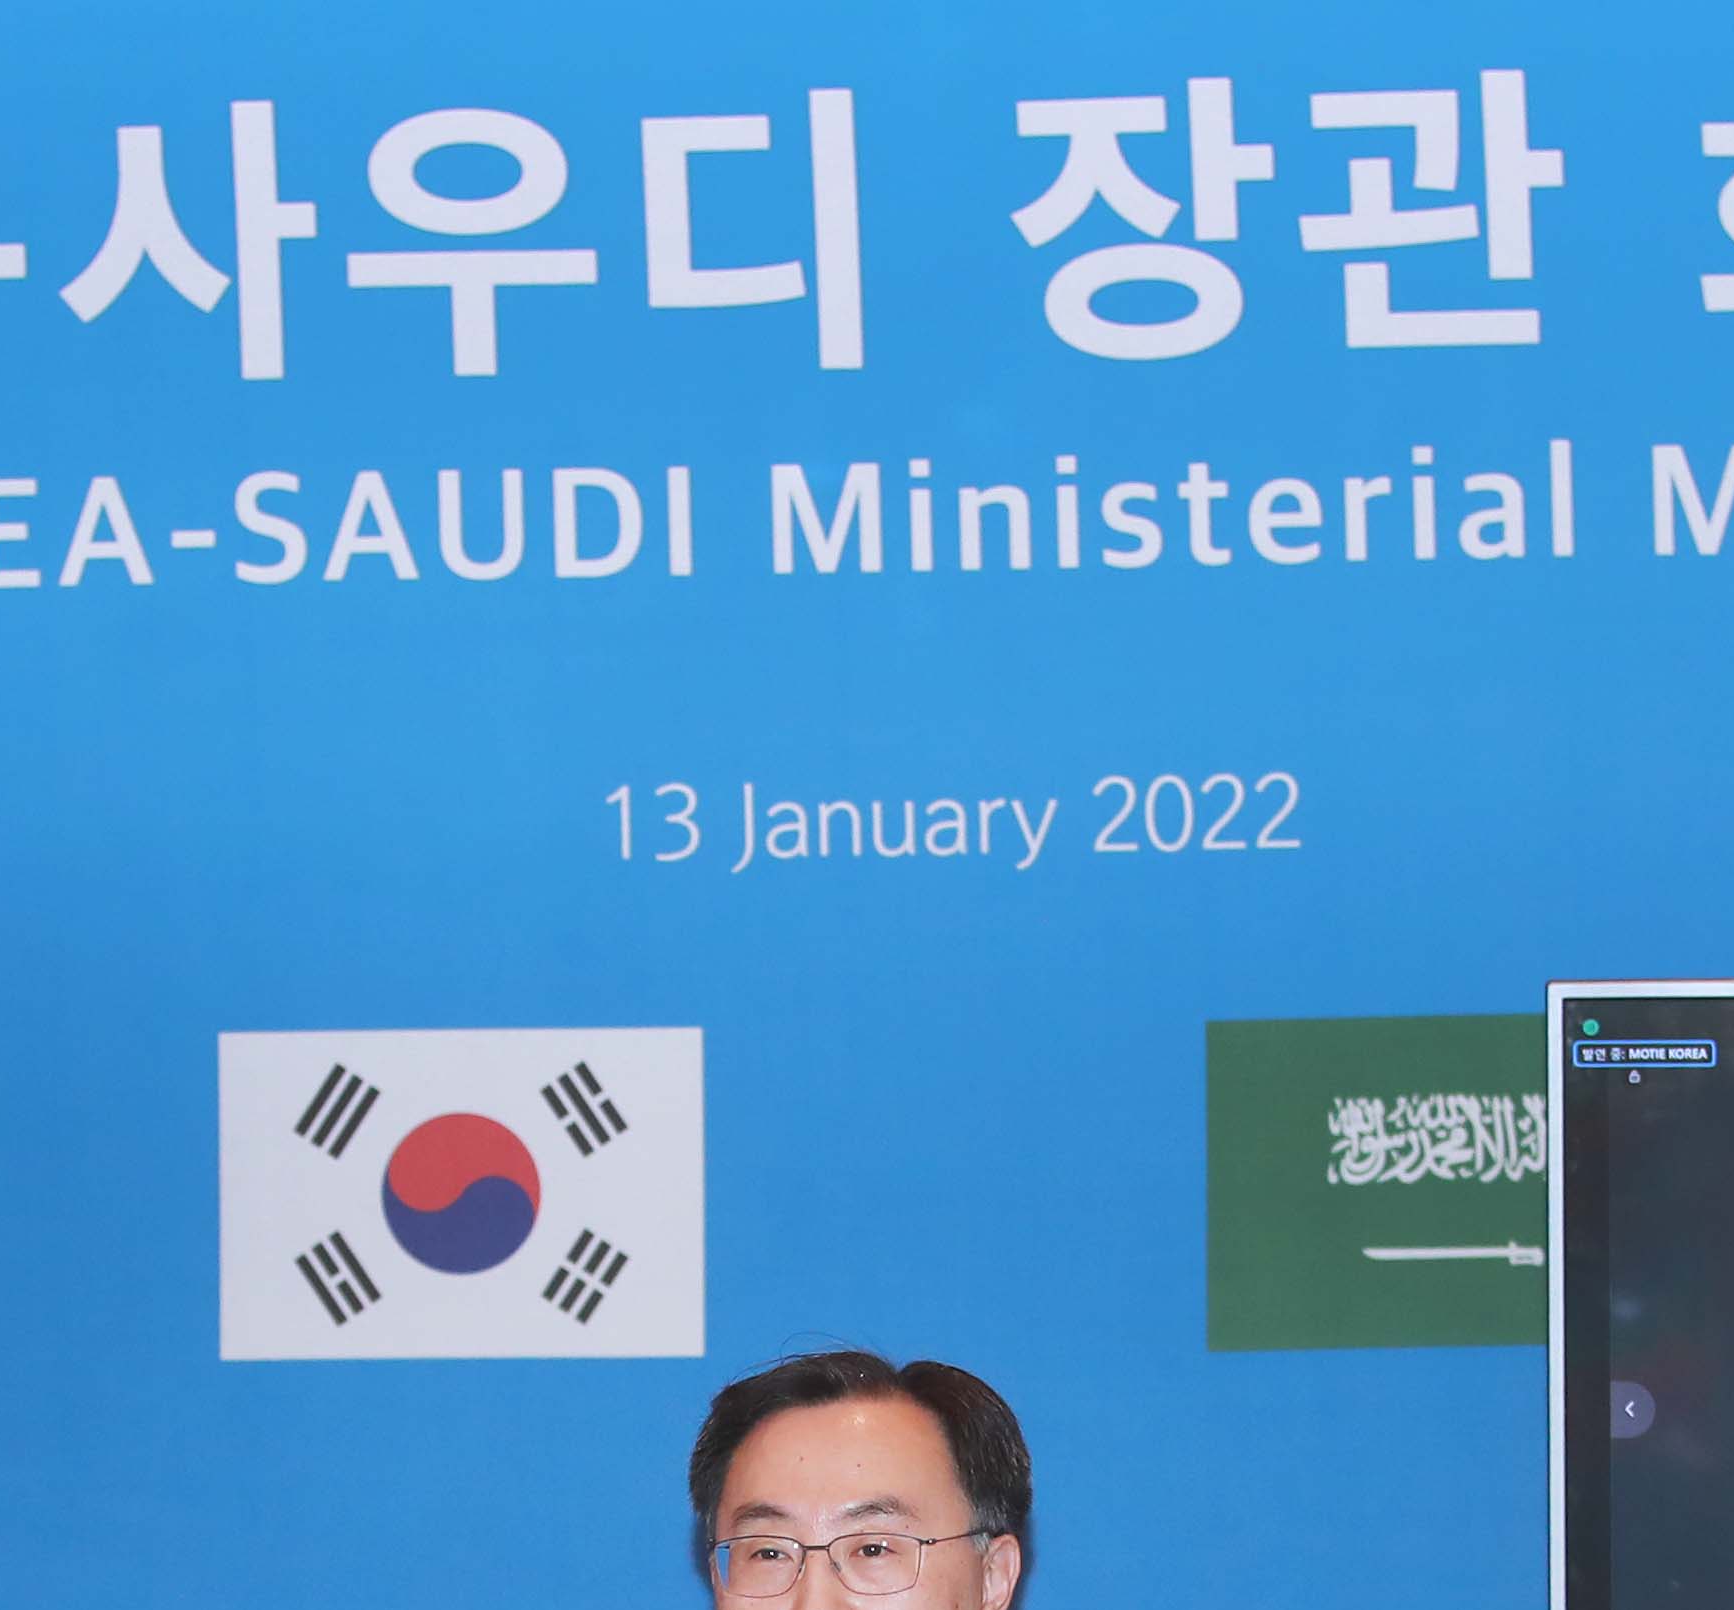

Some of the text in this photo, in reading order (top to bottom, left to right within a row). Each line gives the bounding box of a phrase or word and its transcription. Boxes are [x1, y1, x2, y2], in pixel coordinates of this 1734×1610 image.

[1012, 70, 1563, 359] 장관
[772, 440, 1573, 573] Ministerial
[607, 773, 1299, 872] 13 January 2022
[1629, 1047, 1665, 1060] MOTIE
[1668, 1047, 1708, 1060] KOREA
